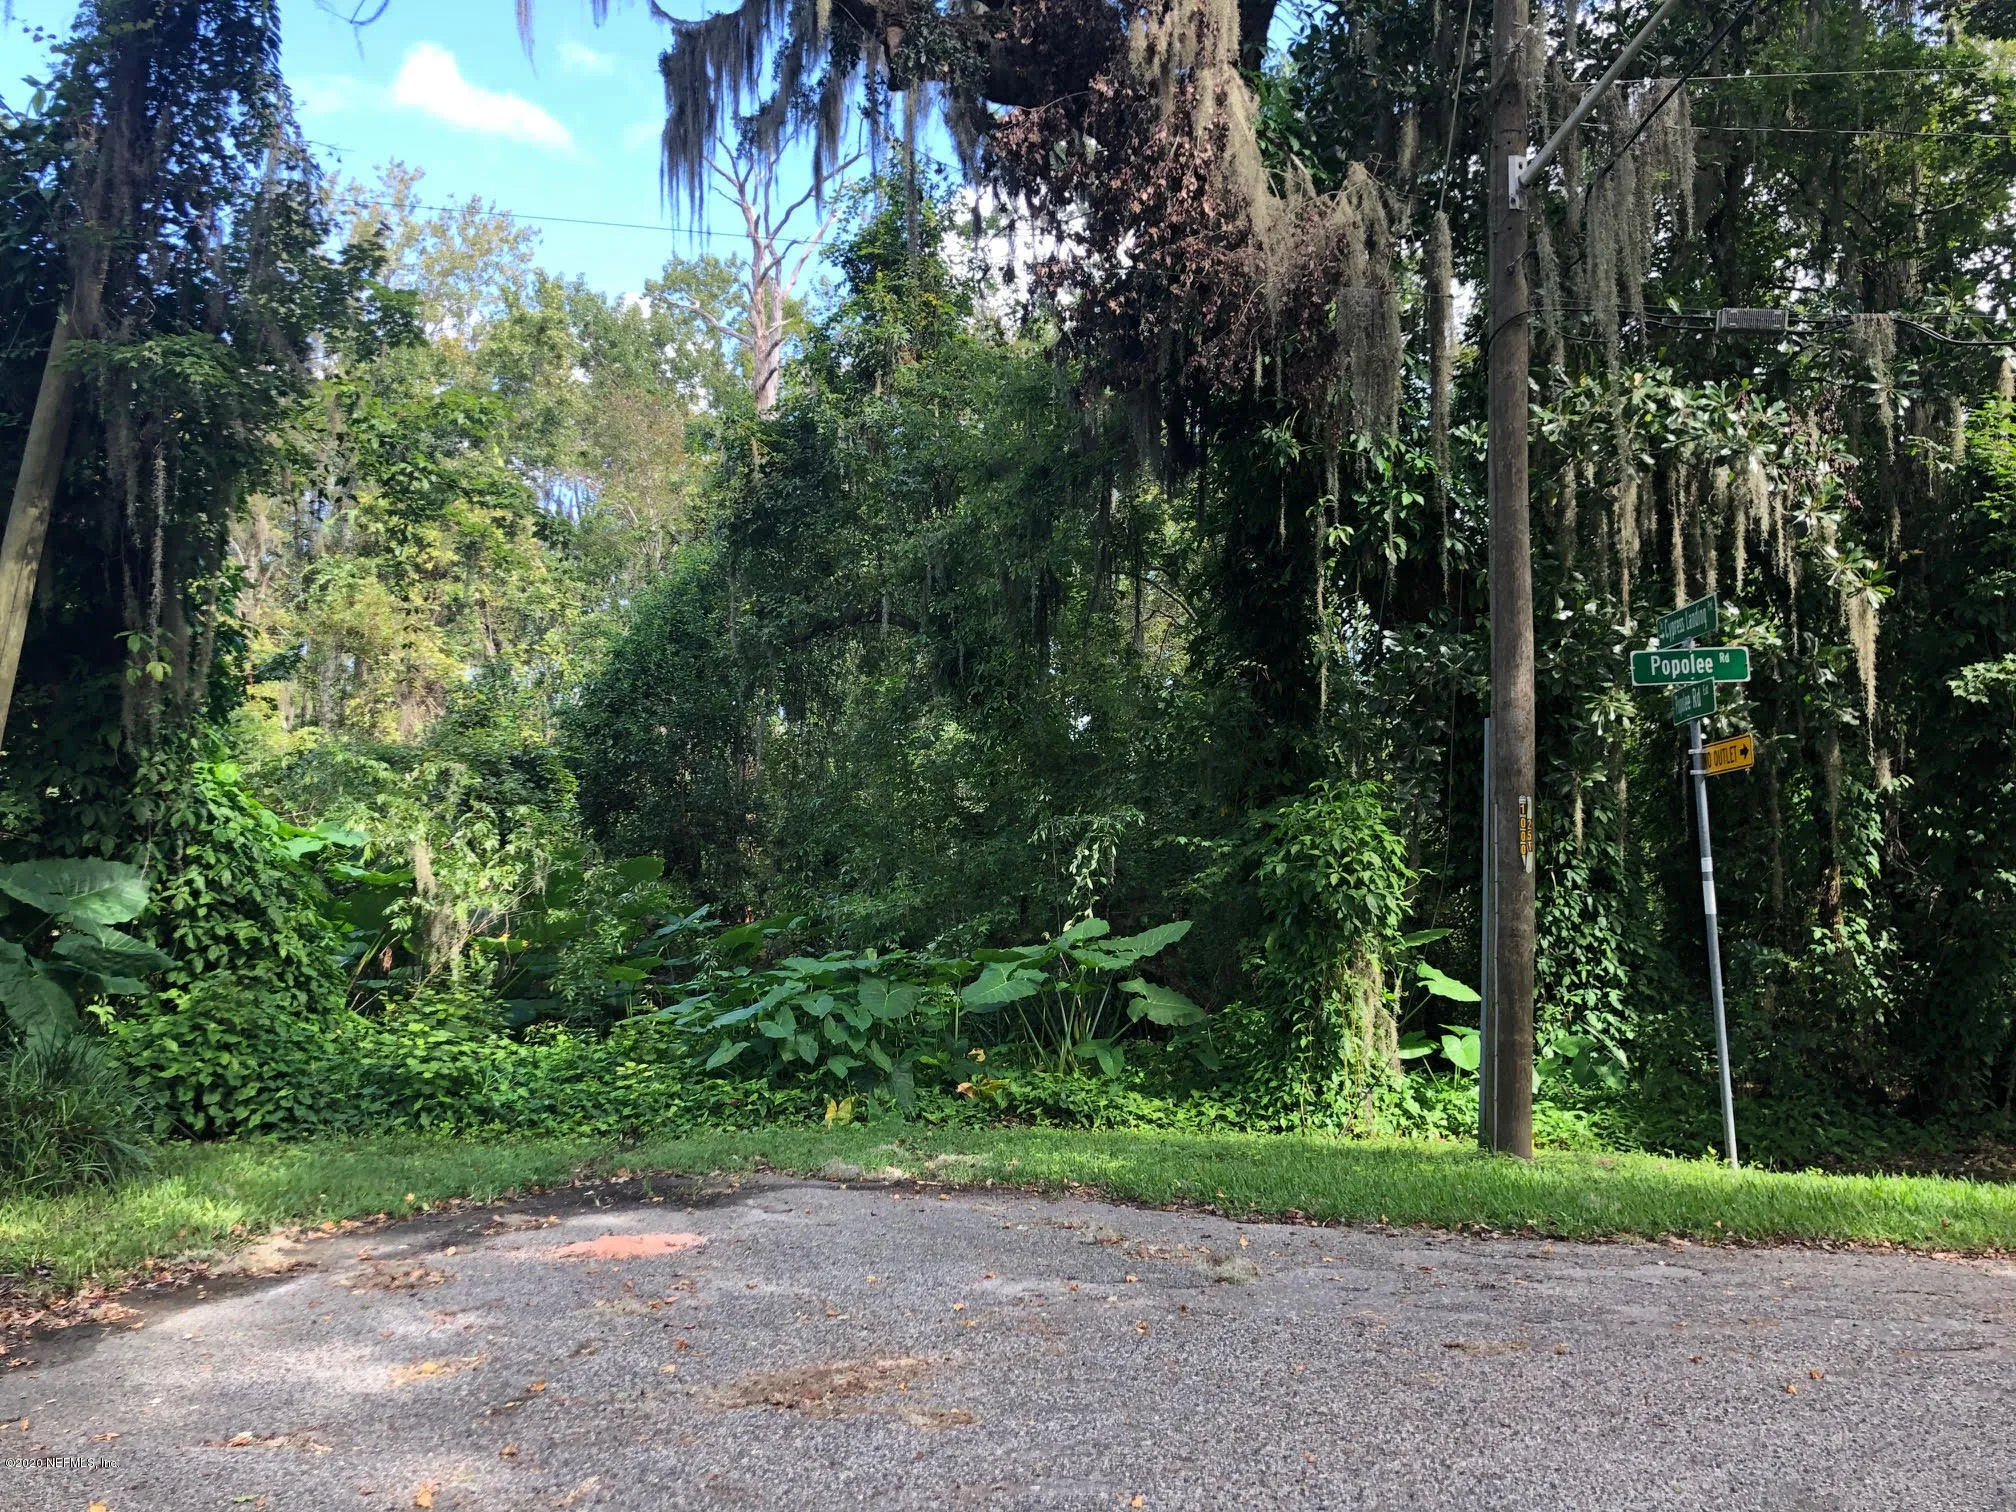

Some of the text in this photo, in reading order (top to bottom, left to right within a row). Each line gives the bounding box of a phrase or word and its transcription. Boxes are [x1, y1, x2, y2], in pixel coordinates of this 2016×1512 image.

[1664, 617, 1685, 643] Cypress
[1685, 605, 1708, 631] Landing
[1650, 652, 1730, 680] Popolee Rd
[1692, 687, 1701, 709] Rd
[1713, 745, 1737, 767] OUTLET
